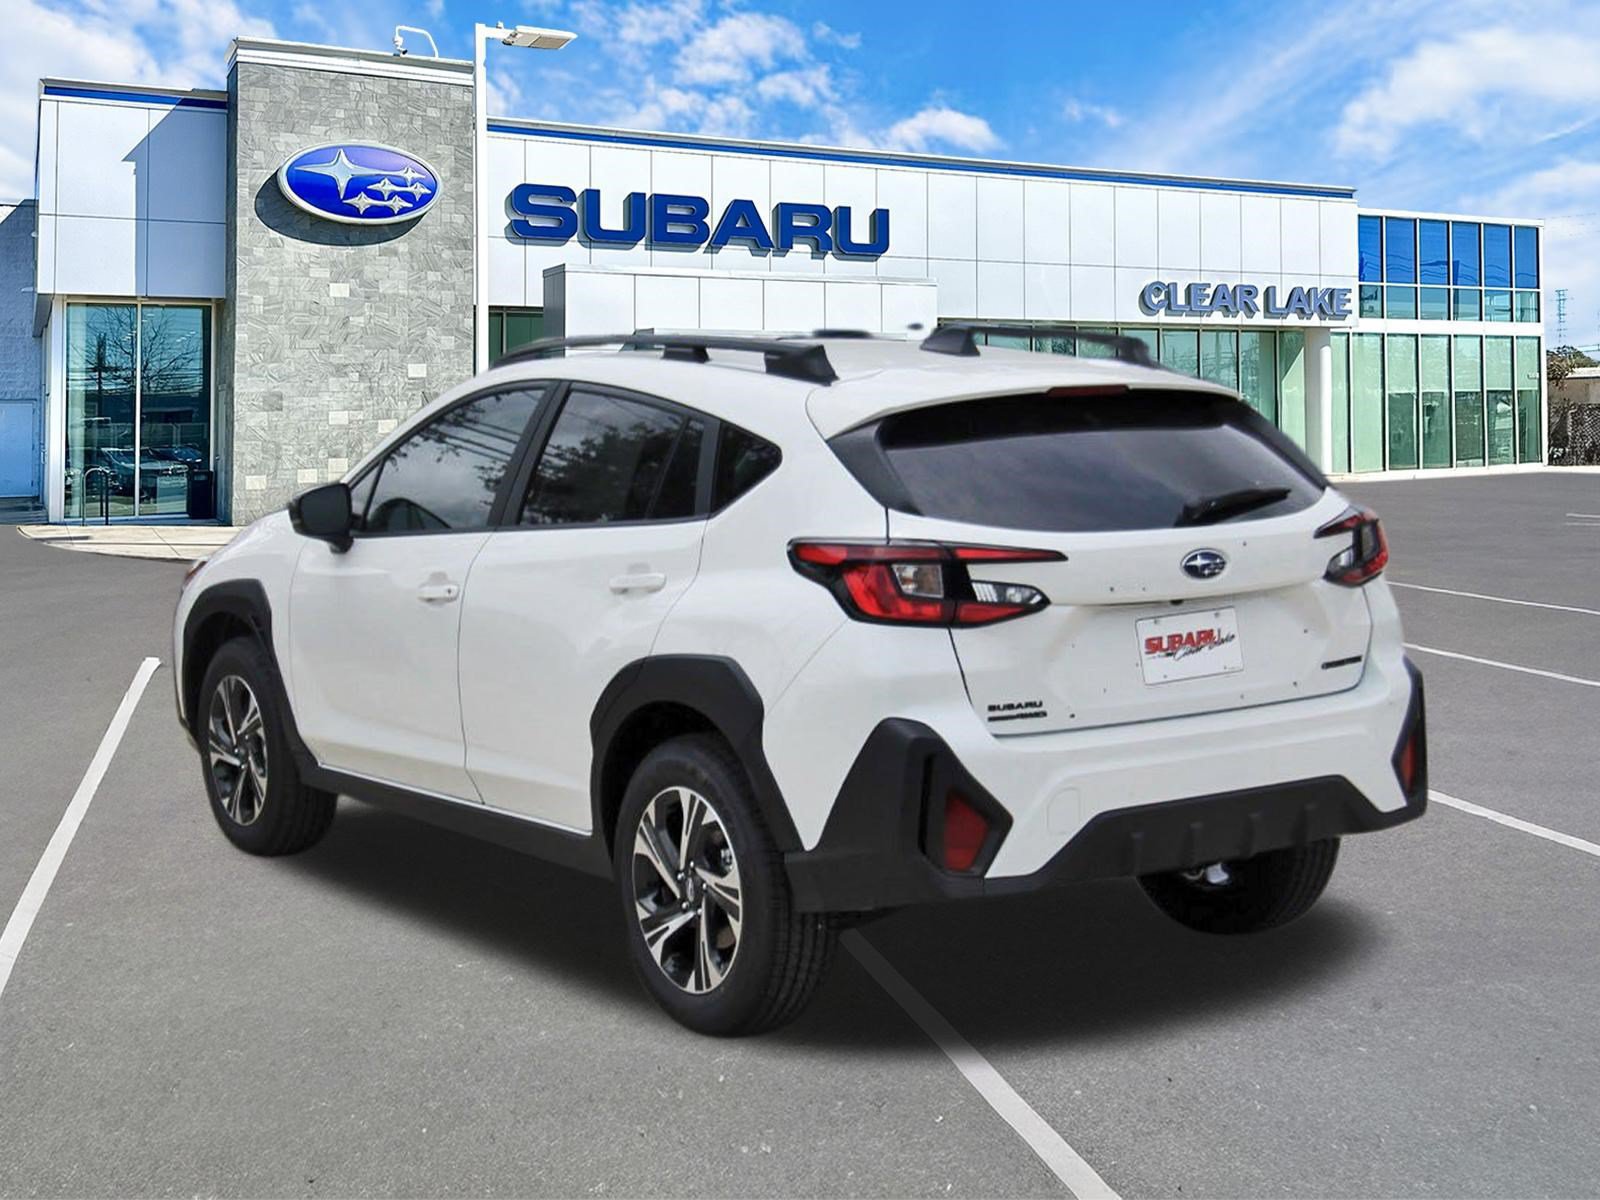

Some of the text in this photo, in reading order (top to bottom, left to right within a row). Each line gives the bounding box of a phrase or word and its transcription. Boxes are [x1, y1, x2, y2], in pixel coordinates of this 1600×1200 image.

[505, 182, 890, 260] SUBARU
[1140, 281, 1352, 320] CLEAR LAKE
[987, 700, 1043, 712] SUBARU
